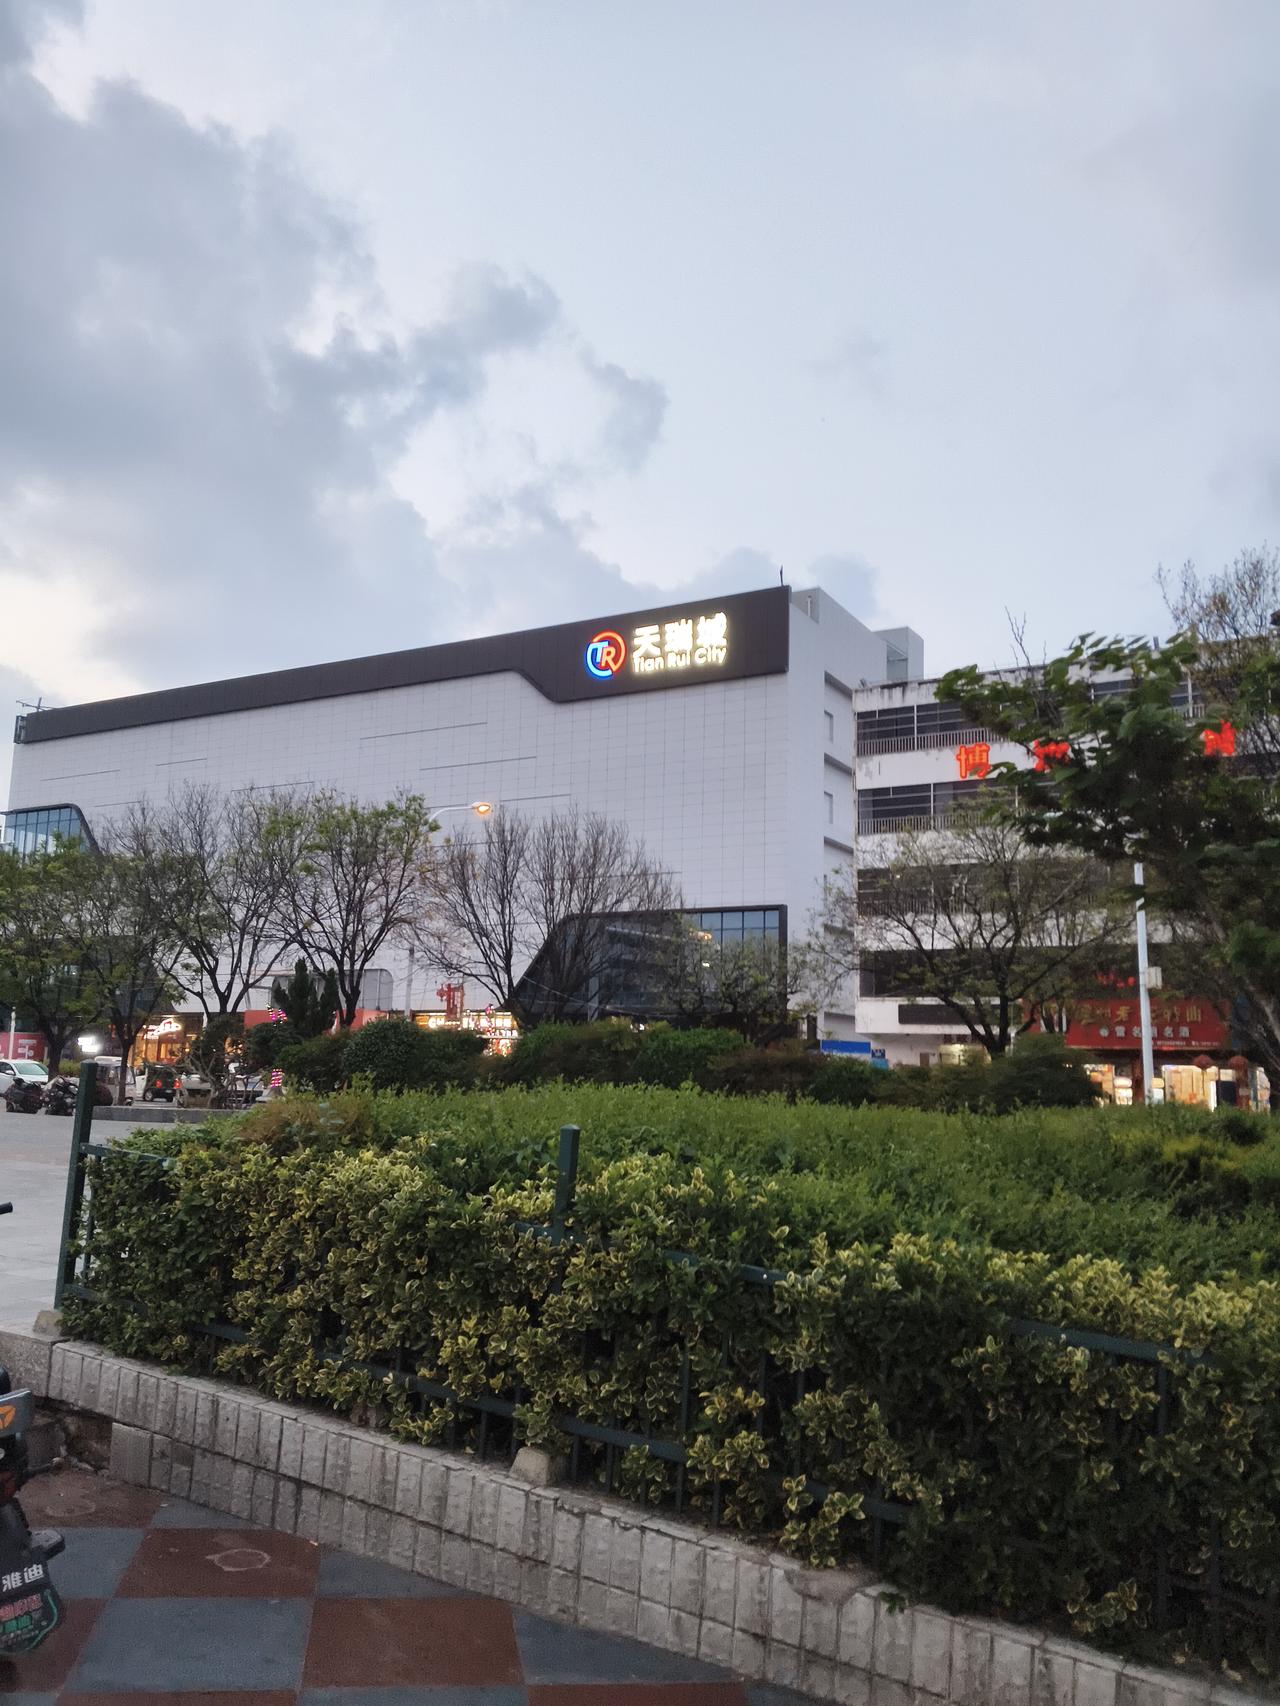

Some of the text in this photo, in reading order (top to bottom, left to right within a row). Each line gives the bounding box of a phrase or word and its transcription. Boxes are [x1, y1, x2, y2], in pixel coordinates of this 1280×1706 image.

[633, 612, 727, 656] 天瑞城
[633, 644, 727, 673] Tian Rui City
[2, 1564, 44, 1592] 雅迪
